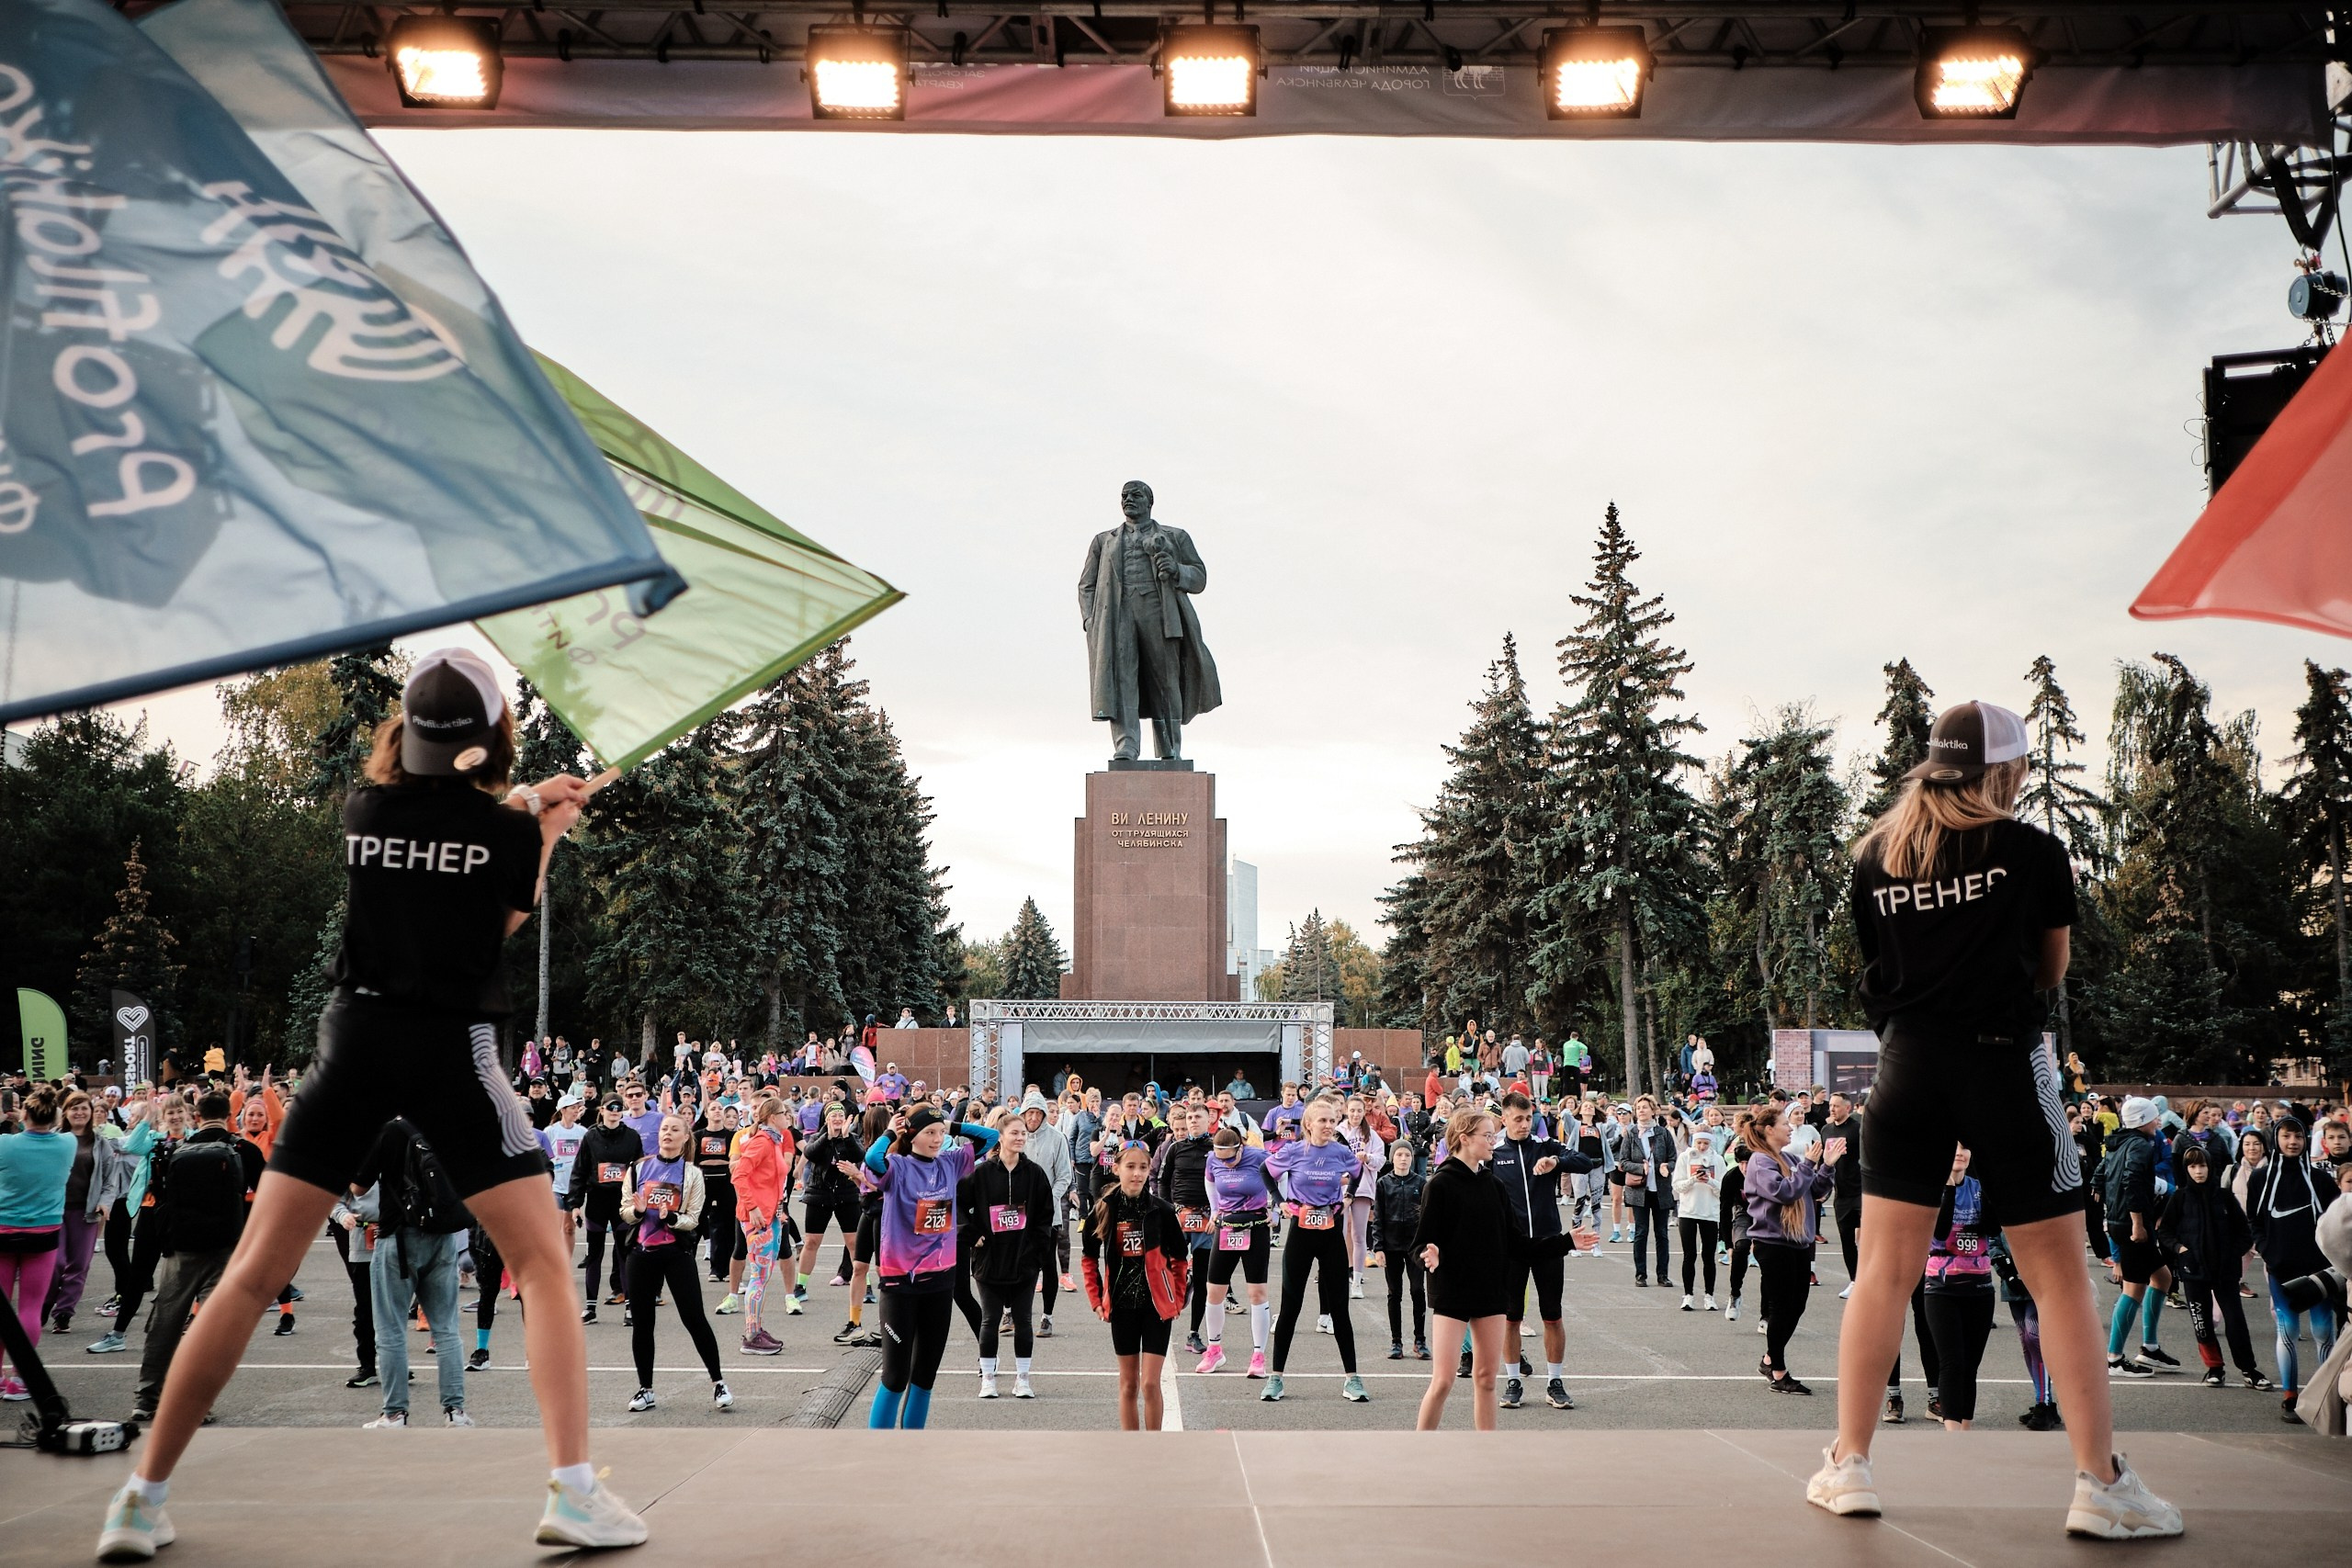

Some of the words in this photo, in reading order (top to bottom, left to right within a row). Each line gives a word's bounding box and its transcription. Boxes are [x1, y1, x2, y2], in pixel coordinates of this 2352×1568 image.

[1137, 812, 1189, 826] ЛЕНИНУ
[1112, 829, 1124, 839] ОТ
[1128, 829, 1189, 839] ТРУДЯЩИХСЯ
[1117, 840, 1183, 848] ЧЕЛЯБИНСКА
[345, 835, 491, 874] ТРЕНЕР
[603, 1170, 622, 1179] 2472
[923, 1214, 946, 1229] 2126
[997, 1215, 1020, 1228] 1493
[1305, 1215, 1329, 1226] 2087
[1123, 1237, 1144, 1251] 212
[1227, 1236, 1244, 1247] 1210
[1957, 1238, 1978, 1251] 999
